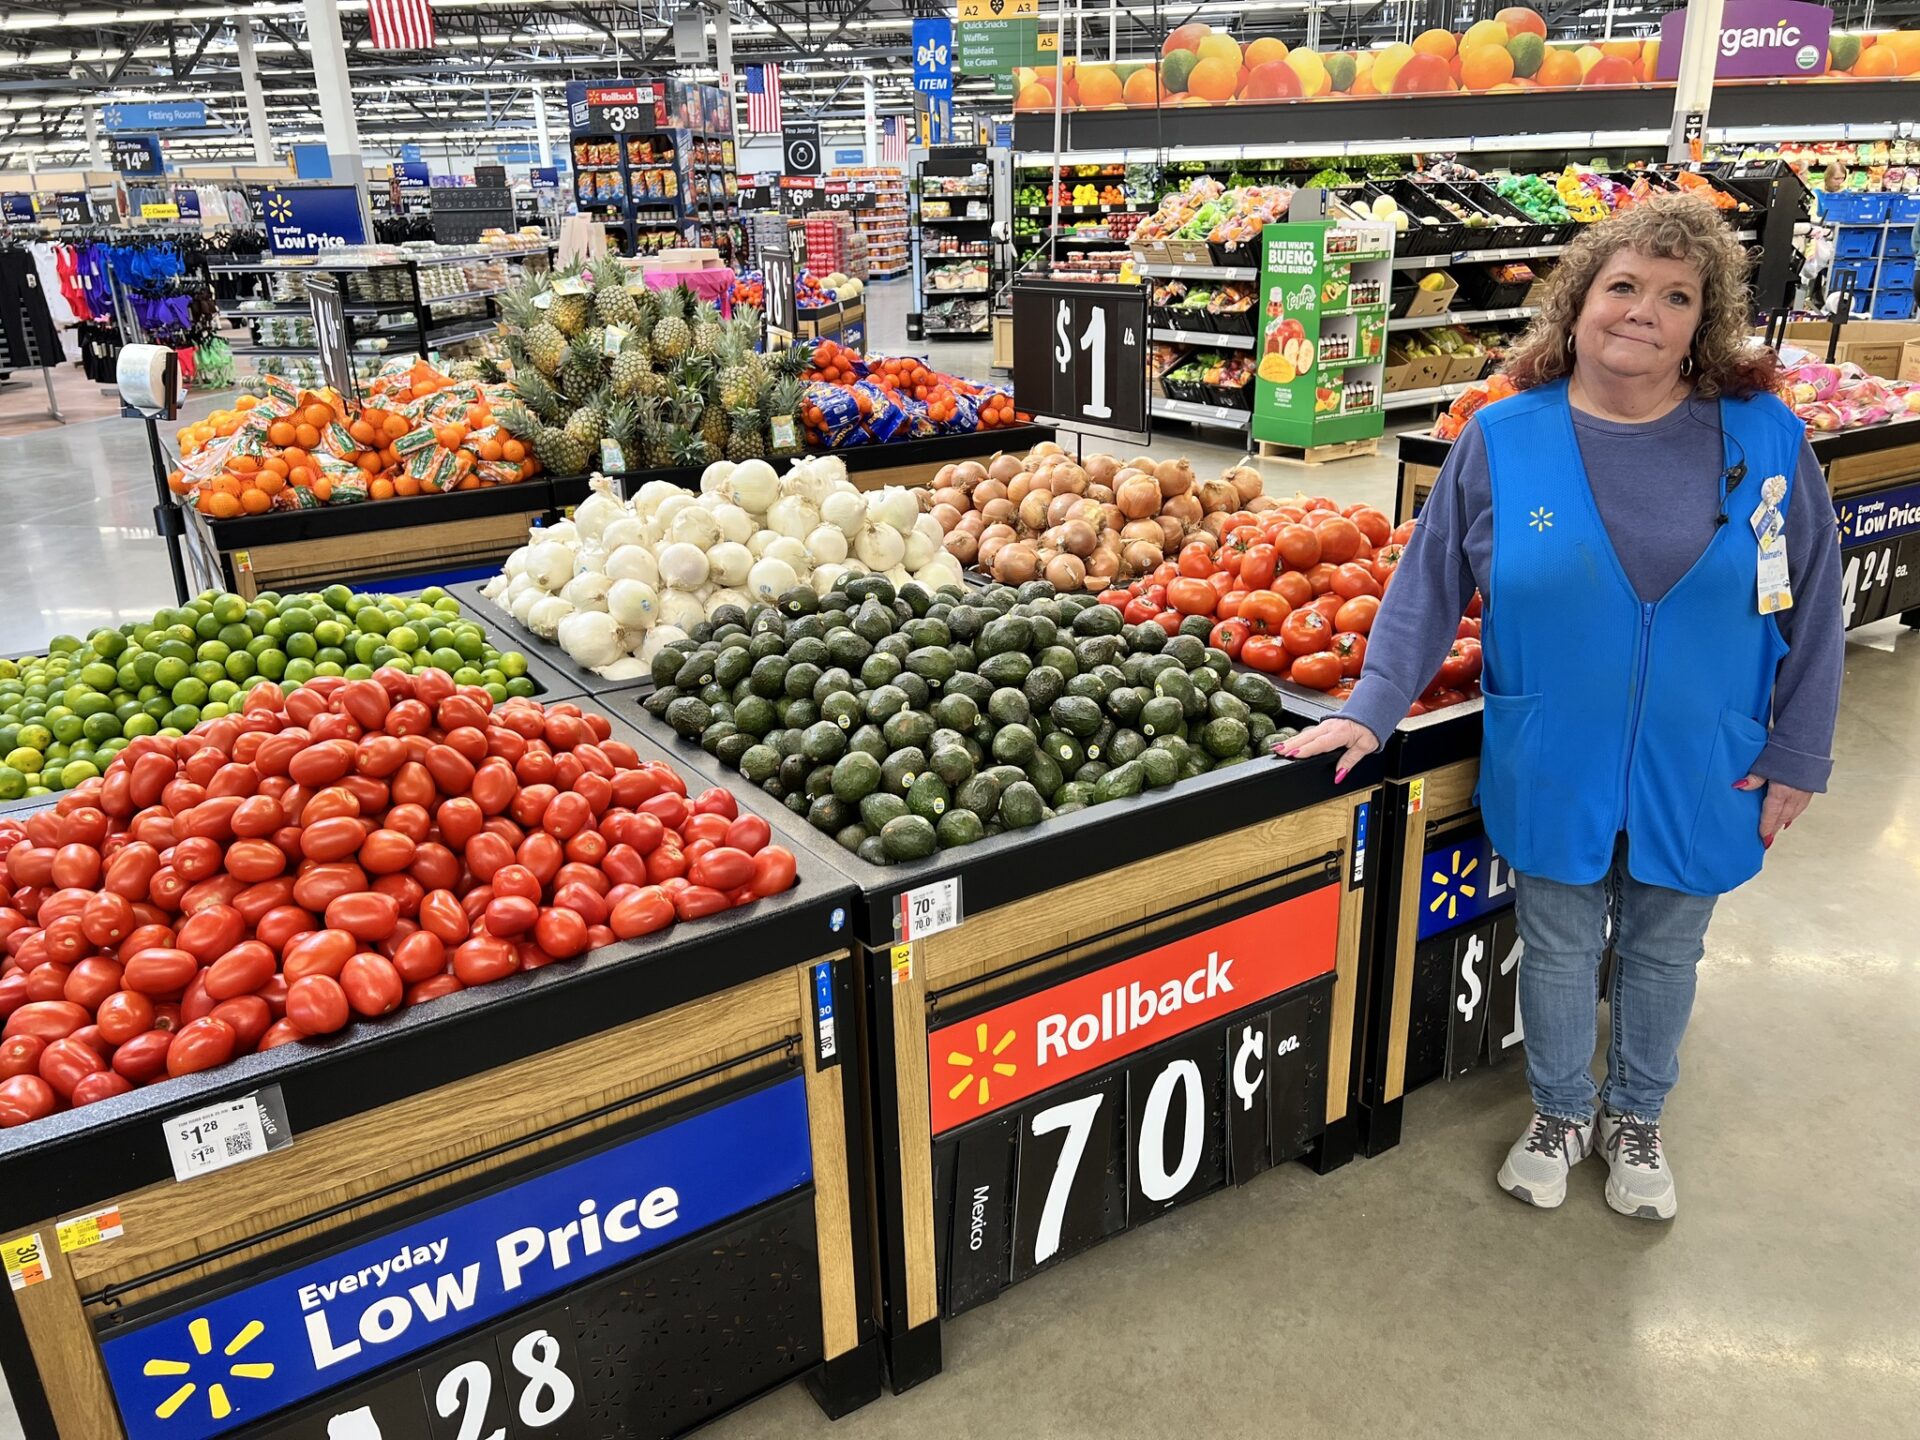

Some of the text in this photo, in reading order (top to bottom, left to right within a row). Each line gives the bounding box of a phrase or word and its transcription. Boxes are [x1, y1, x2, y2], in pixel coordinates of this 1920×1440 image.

[964, 4, 1031, 16] A2 A3
[963, 21, 1008, 30] Quick Snacks
[963, 34, 989, 42] Waffles
[1041, 39, 1053, 47] A5
[1719, 24, 1800, 56] rganic
[917, 50, 947, 62] NEW
[963, 47, 994, 56] Breakfast
[919, 79, 947, 90] ITEM
[601, 92, 634, 101] Rollback
[148, 110, 201, 121] Fitting Rooms
[272, 226, 301, 235] Everyday
[274, 232, 345, 249] Low Price
[1268, 241, 1314, 250] MAKE WHAT'S
[1268, 250, 1318, 267] BUENO,
[1268, 265, 1314, 275] MORE BUENO
[1055, 299, 1136, 418] $1 lb.
[1858, 501, 1885, 514] Everyday
[1855, 503, 1920, 537] Low Price
[1896, 564, 1908, 578] ea.
[1360, 809, 1366, 817] A
[898, 951, 909, 965] 31
[819, 970, 827, 979] A
[821, 987, 827, 996] 1
[819, 1005, 832, 1017] 30
[1036, 951, 1235, 1066] Rollback
[821, 1035, 833, 1053] 30
[1277, 1031, 1300, 1056] ea.
[258, 1104, 278, 1135] Mexico
[969, 1184, 990, 1251] Mexico
[17, 1244, 40, 1264] 30
[298, 1237, 449, 1311] Everyday
[304, 1186, 679, 1371] Low Price
